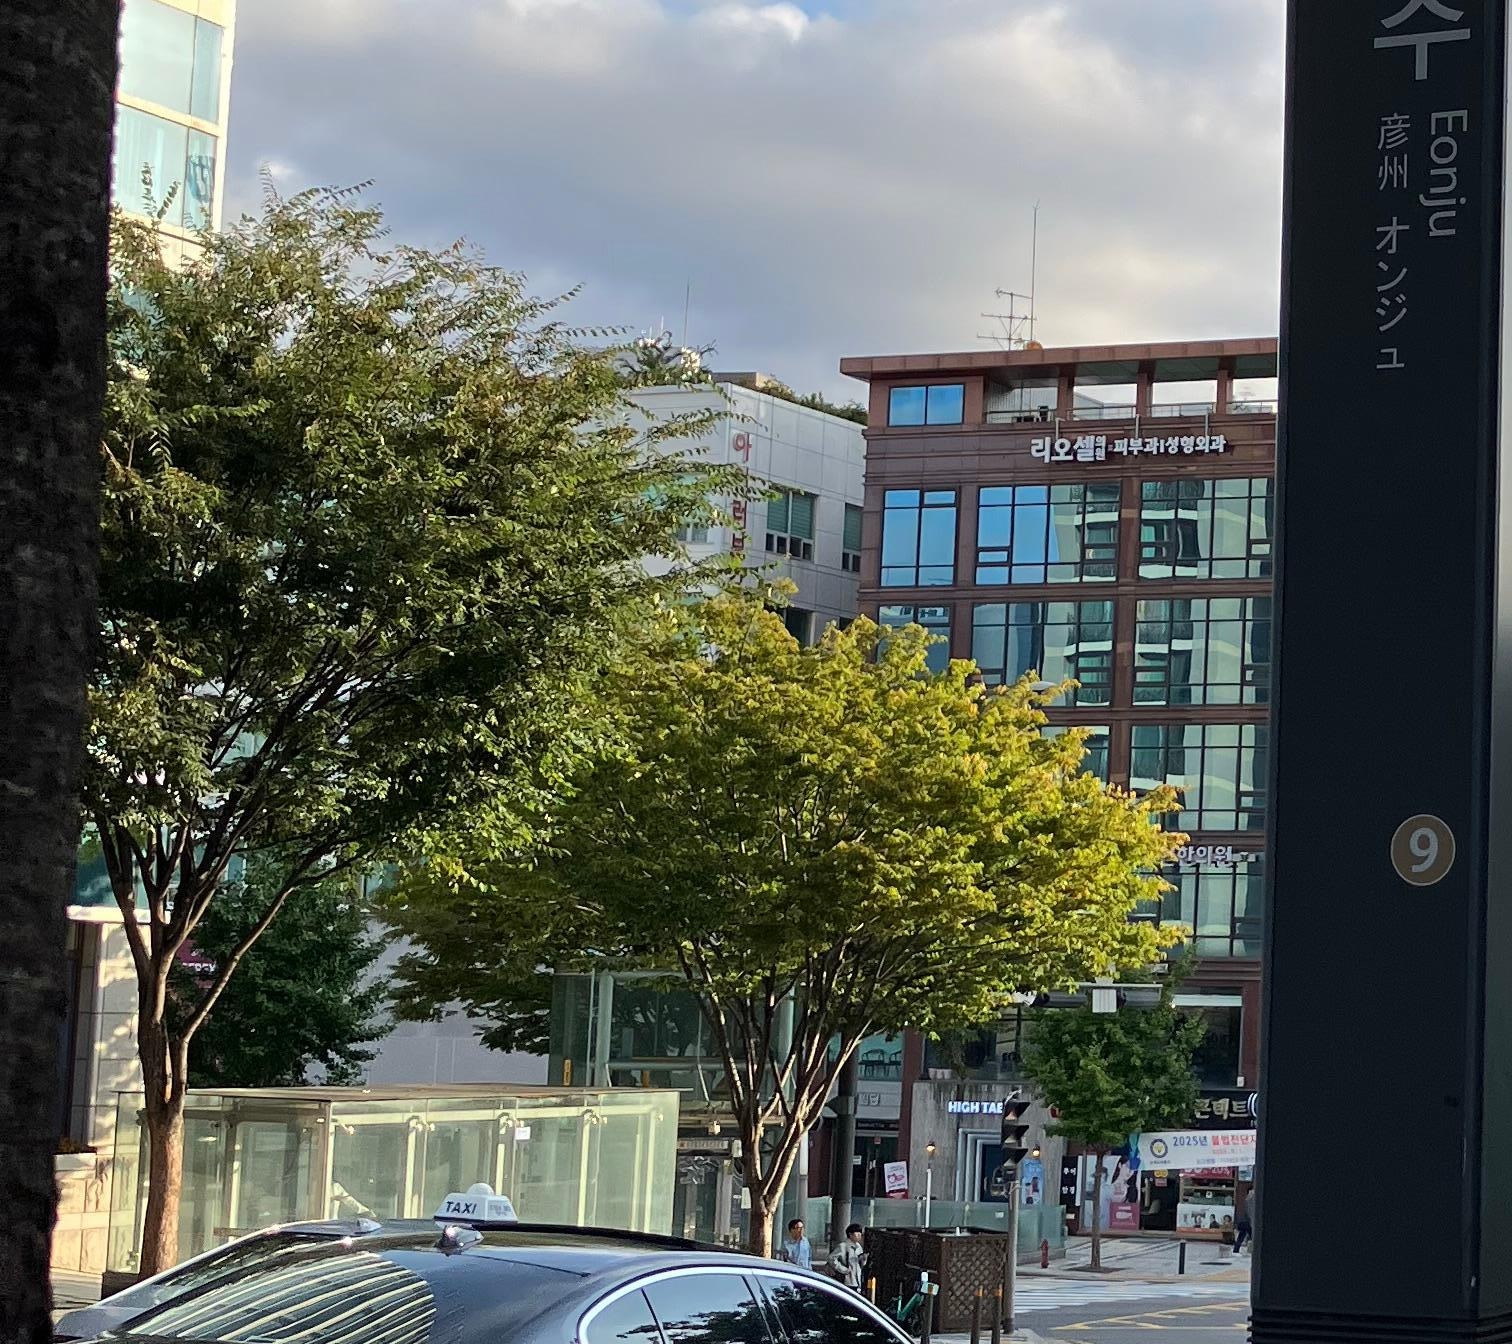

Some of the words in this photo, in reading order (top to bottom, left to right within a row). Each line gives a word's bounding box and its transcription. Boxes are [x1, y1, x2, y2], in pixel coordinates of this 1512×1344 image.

[1417, 108, 1469, 238] Eonju
[1375, 216, 1411, 370] オンジュ
[1409, 827, 1439, 873] 9
[948, 1101, 980, 1114] HIGH
[1172, 1135, 1209, 1147] 2025년
[446, 1200, 478, 1214] TAXI
